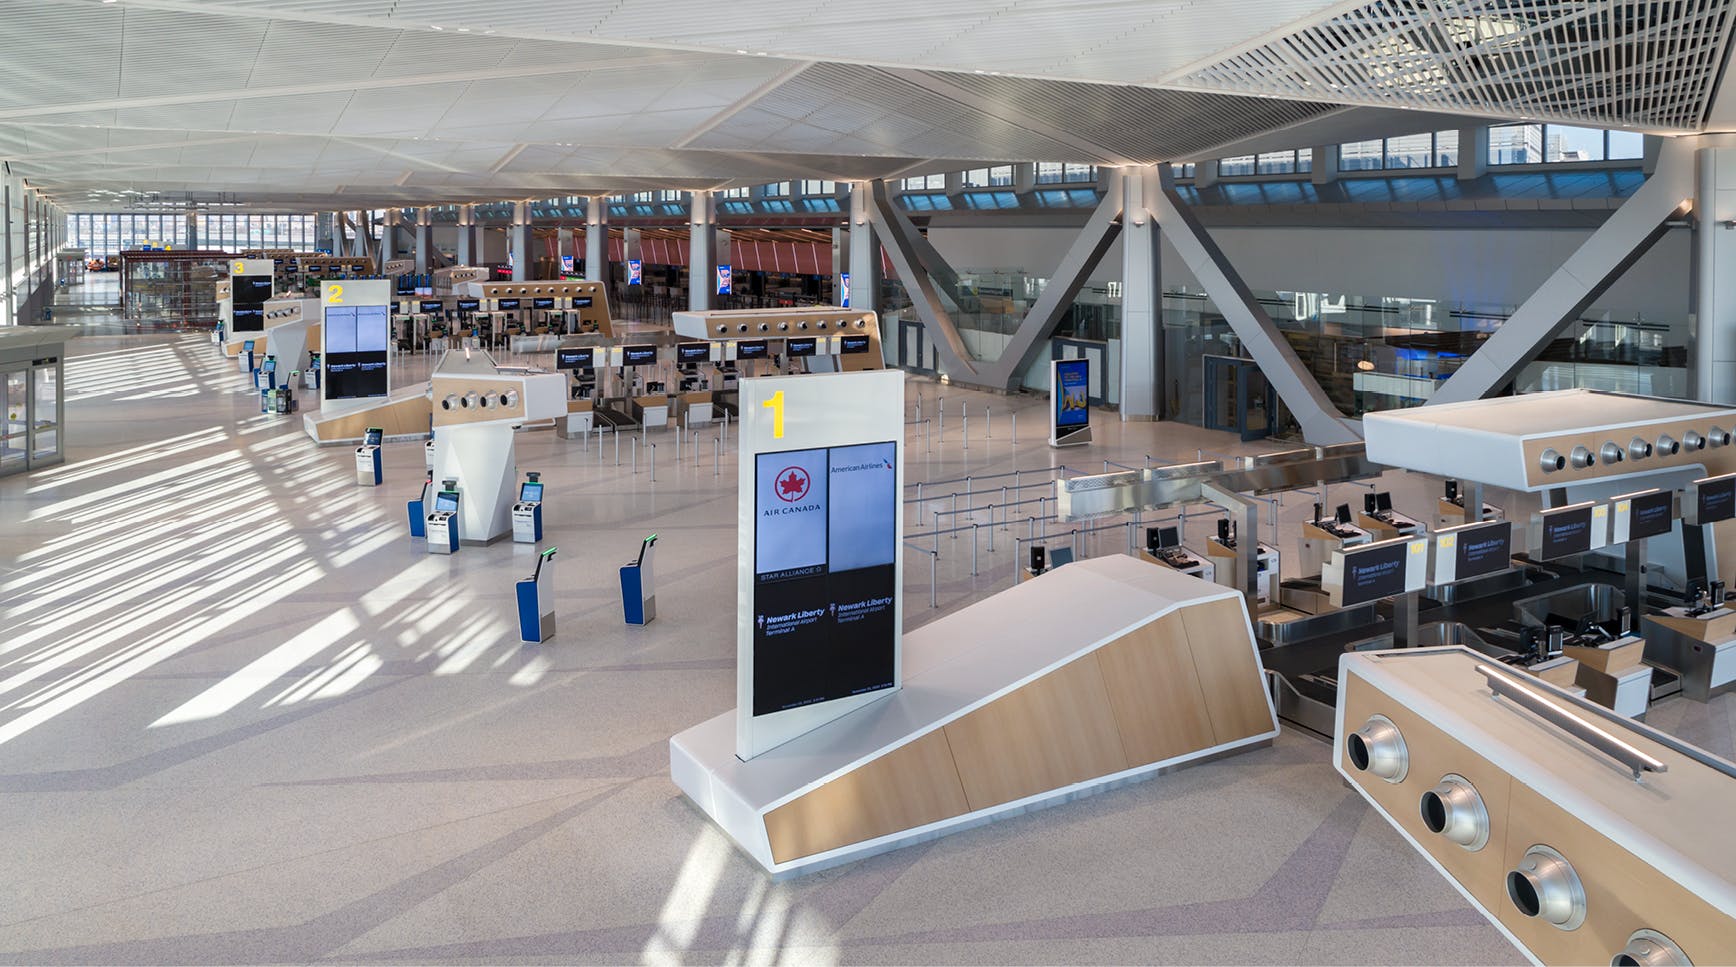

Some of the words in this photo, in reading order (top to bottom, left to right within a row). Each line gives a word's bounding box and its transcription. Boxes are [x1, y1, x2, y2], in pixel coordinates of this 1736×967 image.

[234, 261, 244, 274] 3
[328, 284, 344, 303] 2
[762, 390, 784, 439] 1
[831, 465, 860, 473] American
[860, 462, 883, 470] Airlines
[764, 508, 780, 517] AIR
[782, 504, 821, 515] CANADA
[1380, 560, 1400, 570] Liberty
[761, 573, 779, 581] STAR
[779, 567, 814, 578] ALLIANCE
[838, 601, 866, 611] Newark
[867, 597, 893, 607] Liberty
[766, 612, 797, 624] Newark
[797, 608, 825, 619] Liberty
[766, 620, 799, 630] International
[800, 617, 817, 626] Airport
[766, 627, 791, 636] Terminal
